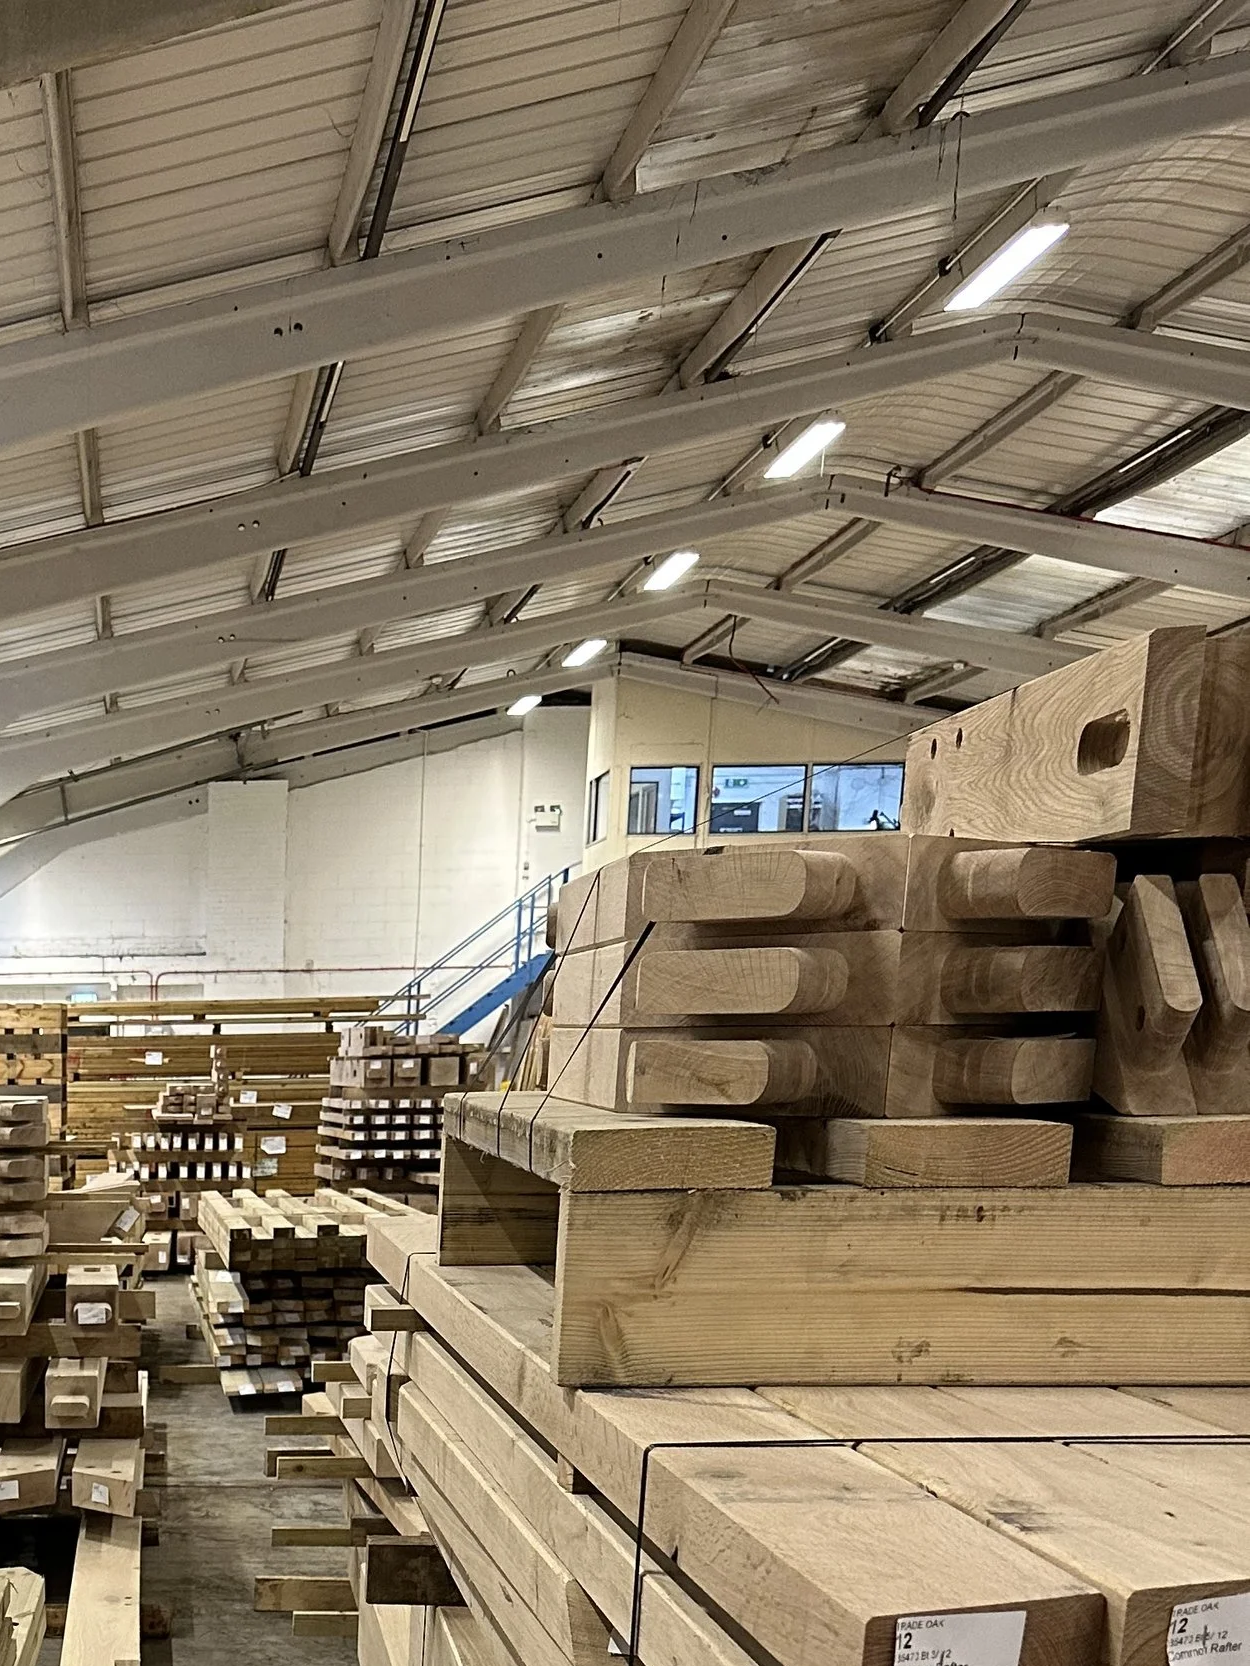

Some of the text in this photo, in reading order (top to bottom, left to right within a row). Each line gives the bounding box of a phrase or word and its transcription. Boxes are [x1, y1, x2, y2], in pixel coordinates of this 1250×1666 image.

[925, 1619, 945, 1628] OAK
[1172, 1617, 1189, 1635] 12
[897, 1632, 912, 1650] 12
[1210, 1641, 1242, 1654] Rafter
